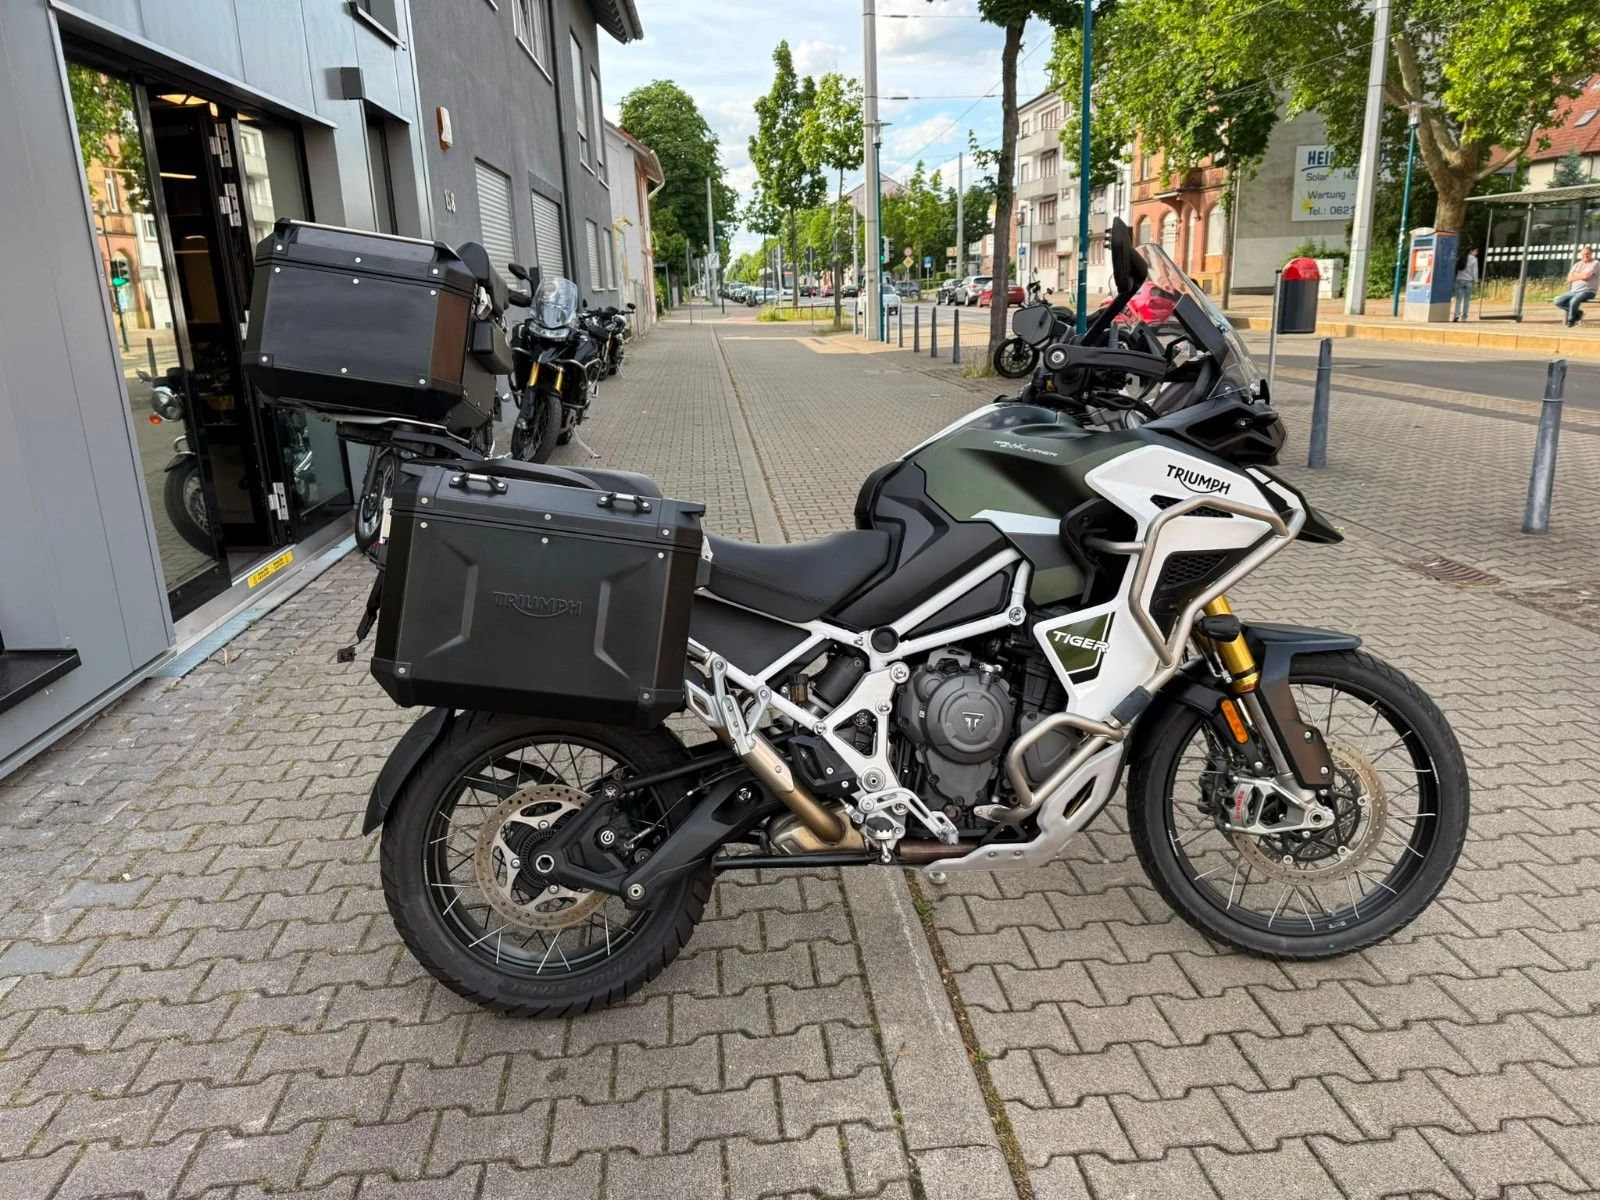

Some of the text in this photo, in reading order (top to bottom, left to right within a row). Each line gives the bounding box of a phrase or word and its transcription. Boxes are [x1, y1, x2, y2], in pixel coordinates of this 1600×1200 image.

[1307, 190, 1346, 201] Wartung
[1308, 206, 1327, 216] Tel.:
[1167, 464, 1231, 495] TRIUMPH
[492, 590, 583, 618] TRIUMPH
[1053, 630, 1110, 654] TIGER
